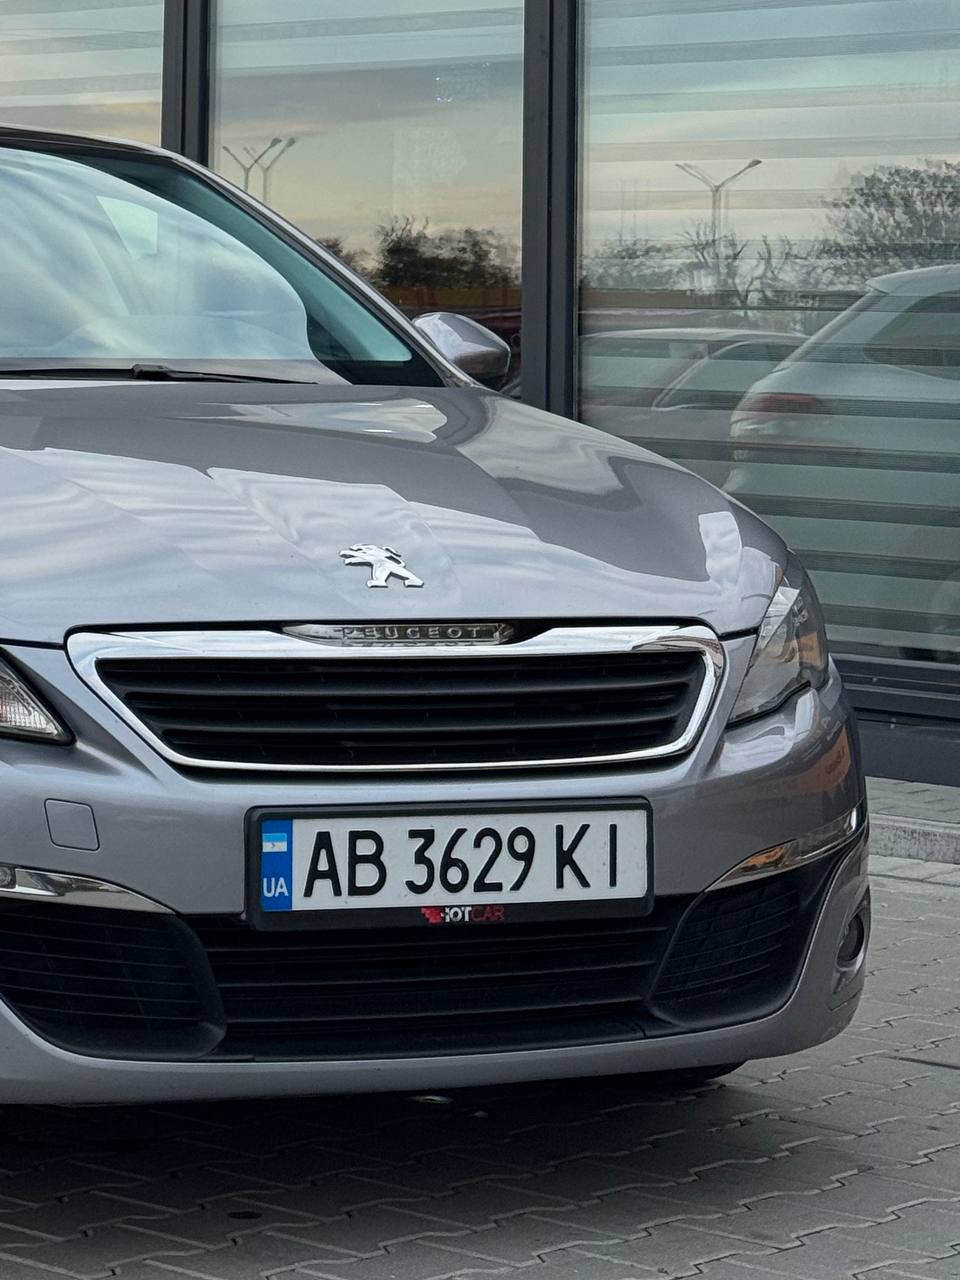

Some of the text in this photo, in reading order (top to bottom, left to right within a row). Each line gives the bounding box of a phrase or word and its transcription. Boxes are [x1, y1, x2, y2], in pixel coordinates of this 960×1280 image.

[342, 627, 481, 640] PEUGEOT
[303, 830, 387, 898] AB
[405, 826, 536, 895] 3629
[263, 876, 289, 898] UA
